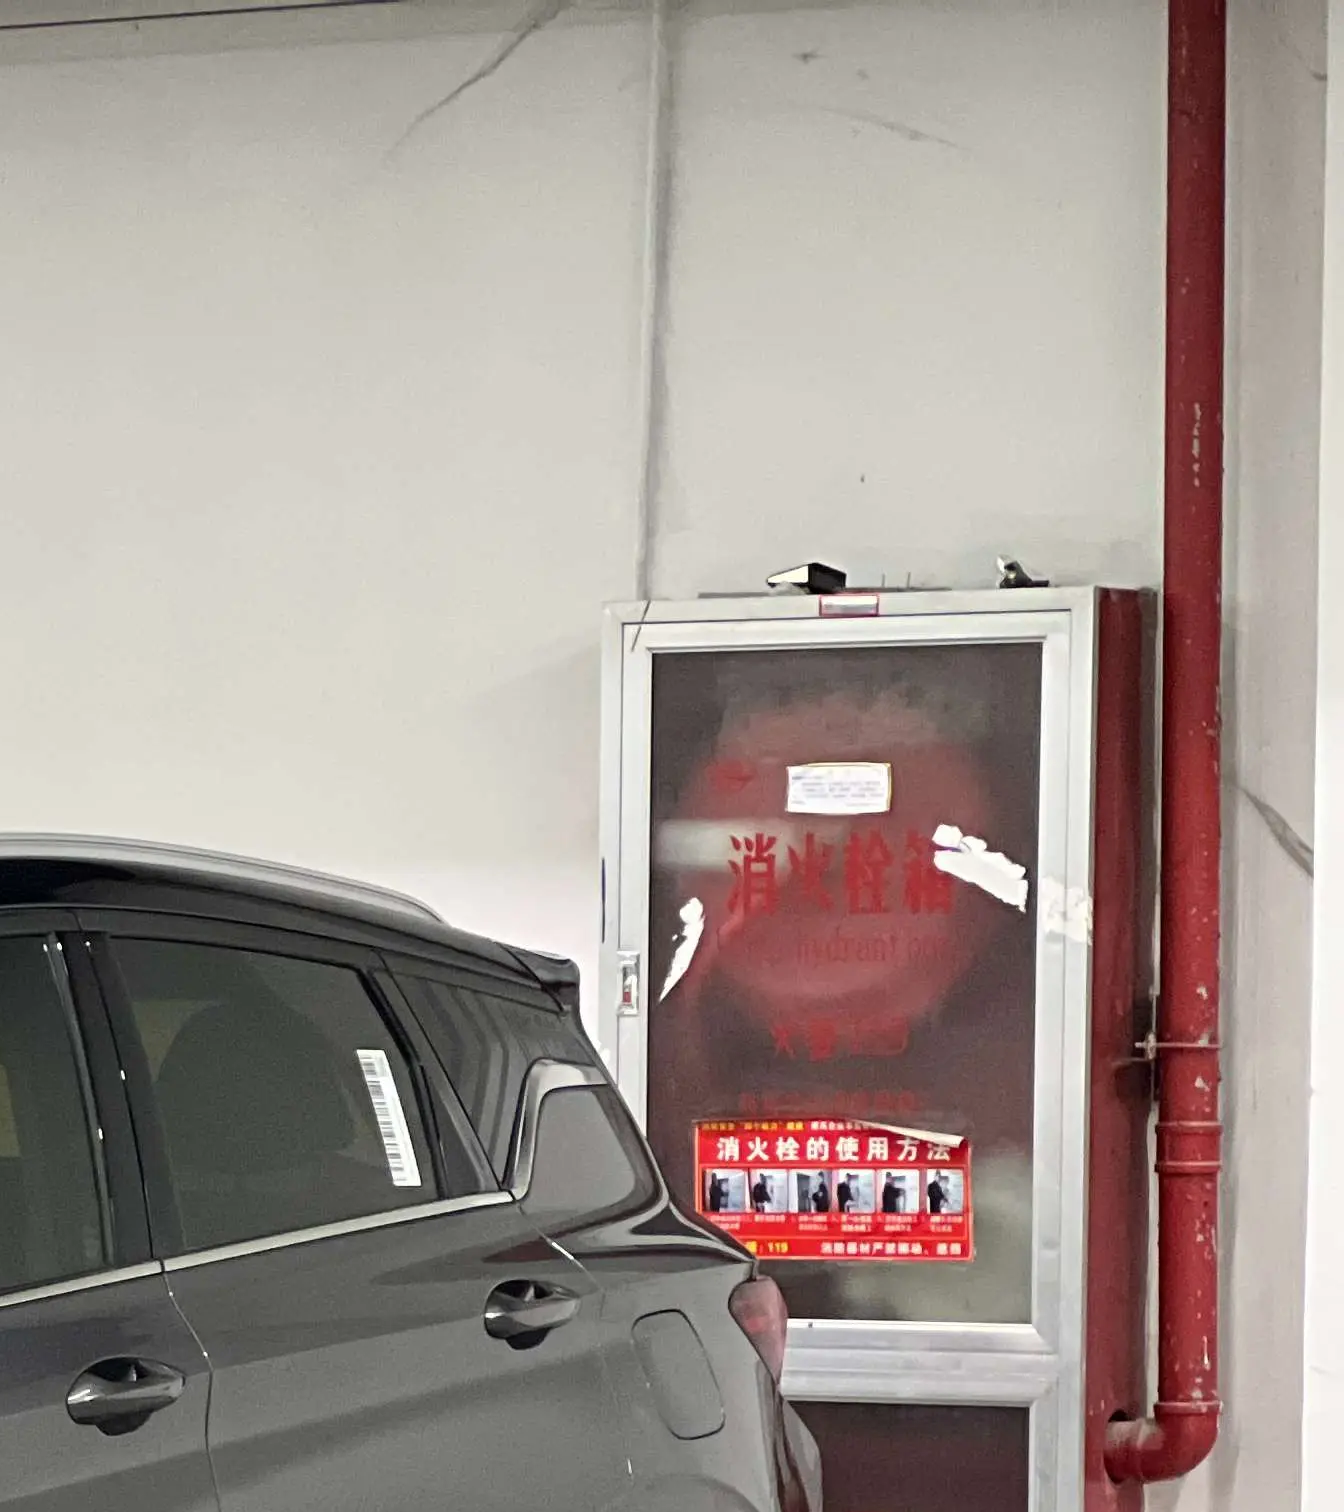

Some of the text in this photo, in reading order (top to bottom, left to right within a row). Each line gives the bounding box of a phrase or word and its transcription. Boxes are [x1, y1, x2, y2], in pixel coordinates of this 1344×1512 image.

[727, 829, 953, 914] 消火栓箱
[716, 1136, 951, 1162] 消火栓的使用方法
